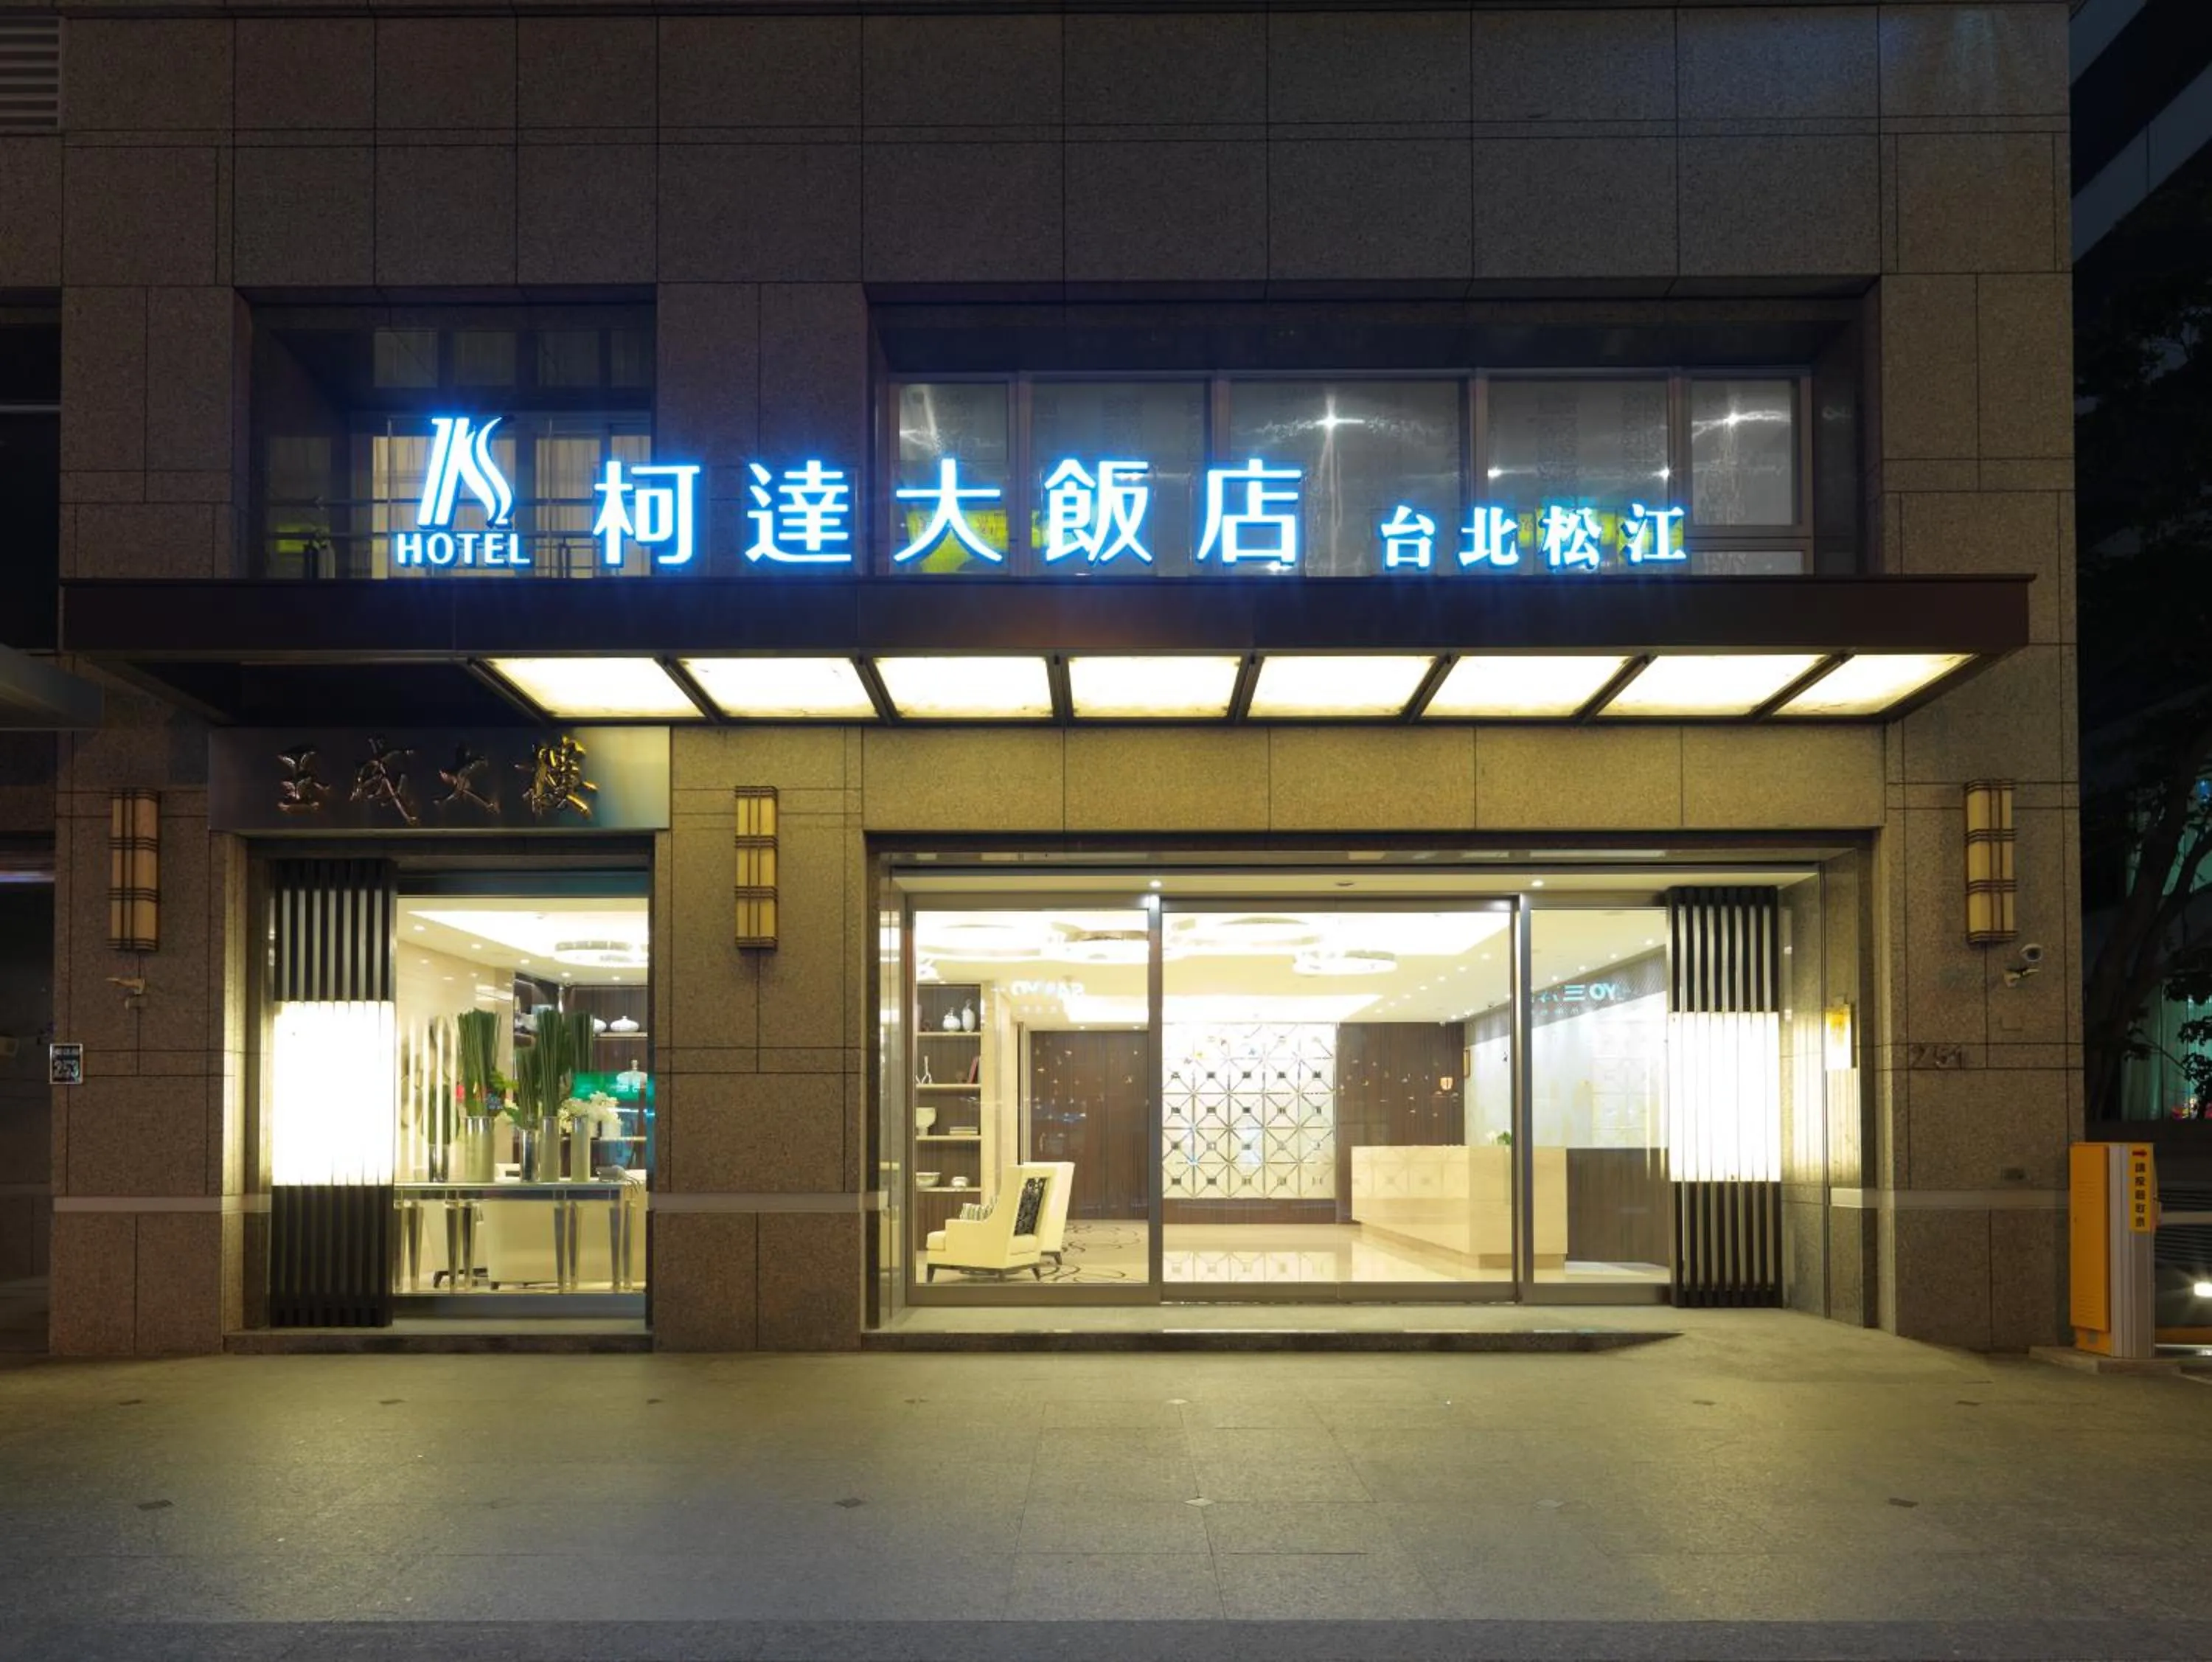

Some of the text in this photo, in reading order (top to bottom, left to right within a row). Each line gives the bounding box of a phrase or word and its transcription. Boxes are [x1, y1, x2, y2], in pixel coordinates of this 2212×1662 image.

[397, 532, 531, 566] HOTEL
[593, 458, 1686, 568] 柯達大飯店 台北松江
